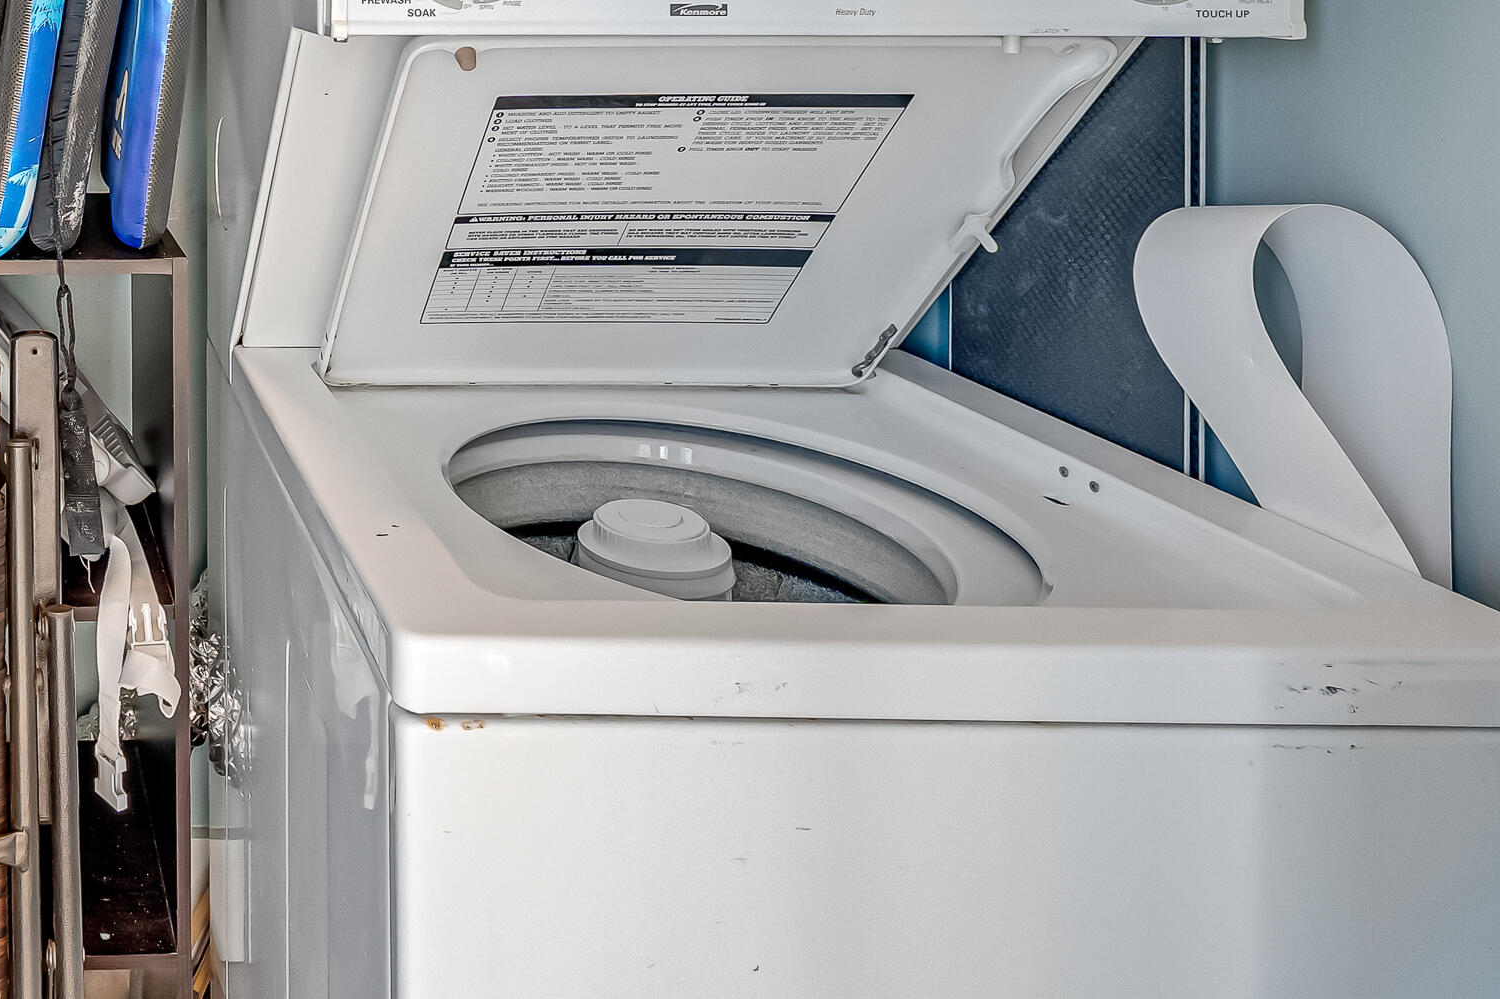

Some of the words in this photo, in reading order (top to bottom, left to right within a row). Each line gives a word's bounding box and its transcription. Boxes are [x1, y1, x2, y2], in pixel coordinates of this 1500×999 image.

[407, 9, 436, 17] SOAK
[680, 8, 726, 16] Kenmore
[836, 8, 858, 16] Heavy
[860, 8, 876, 16] Duty
[1196, 10, 1232, 18] TOUCH
[1236, 10, 1250, 18] UP
